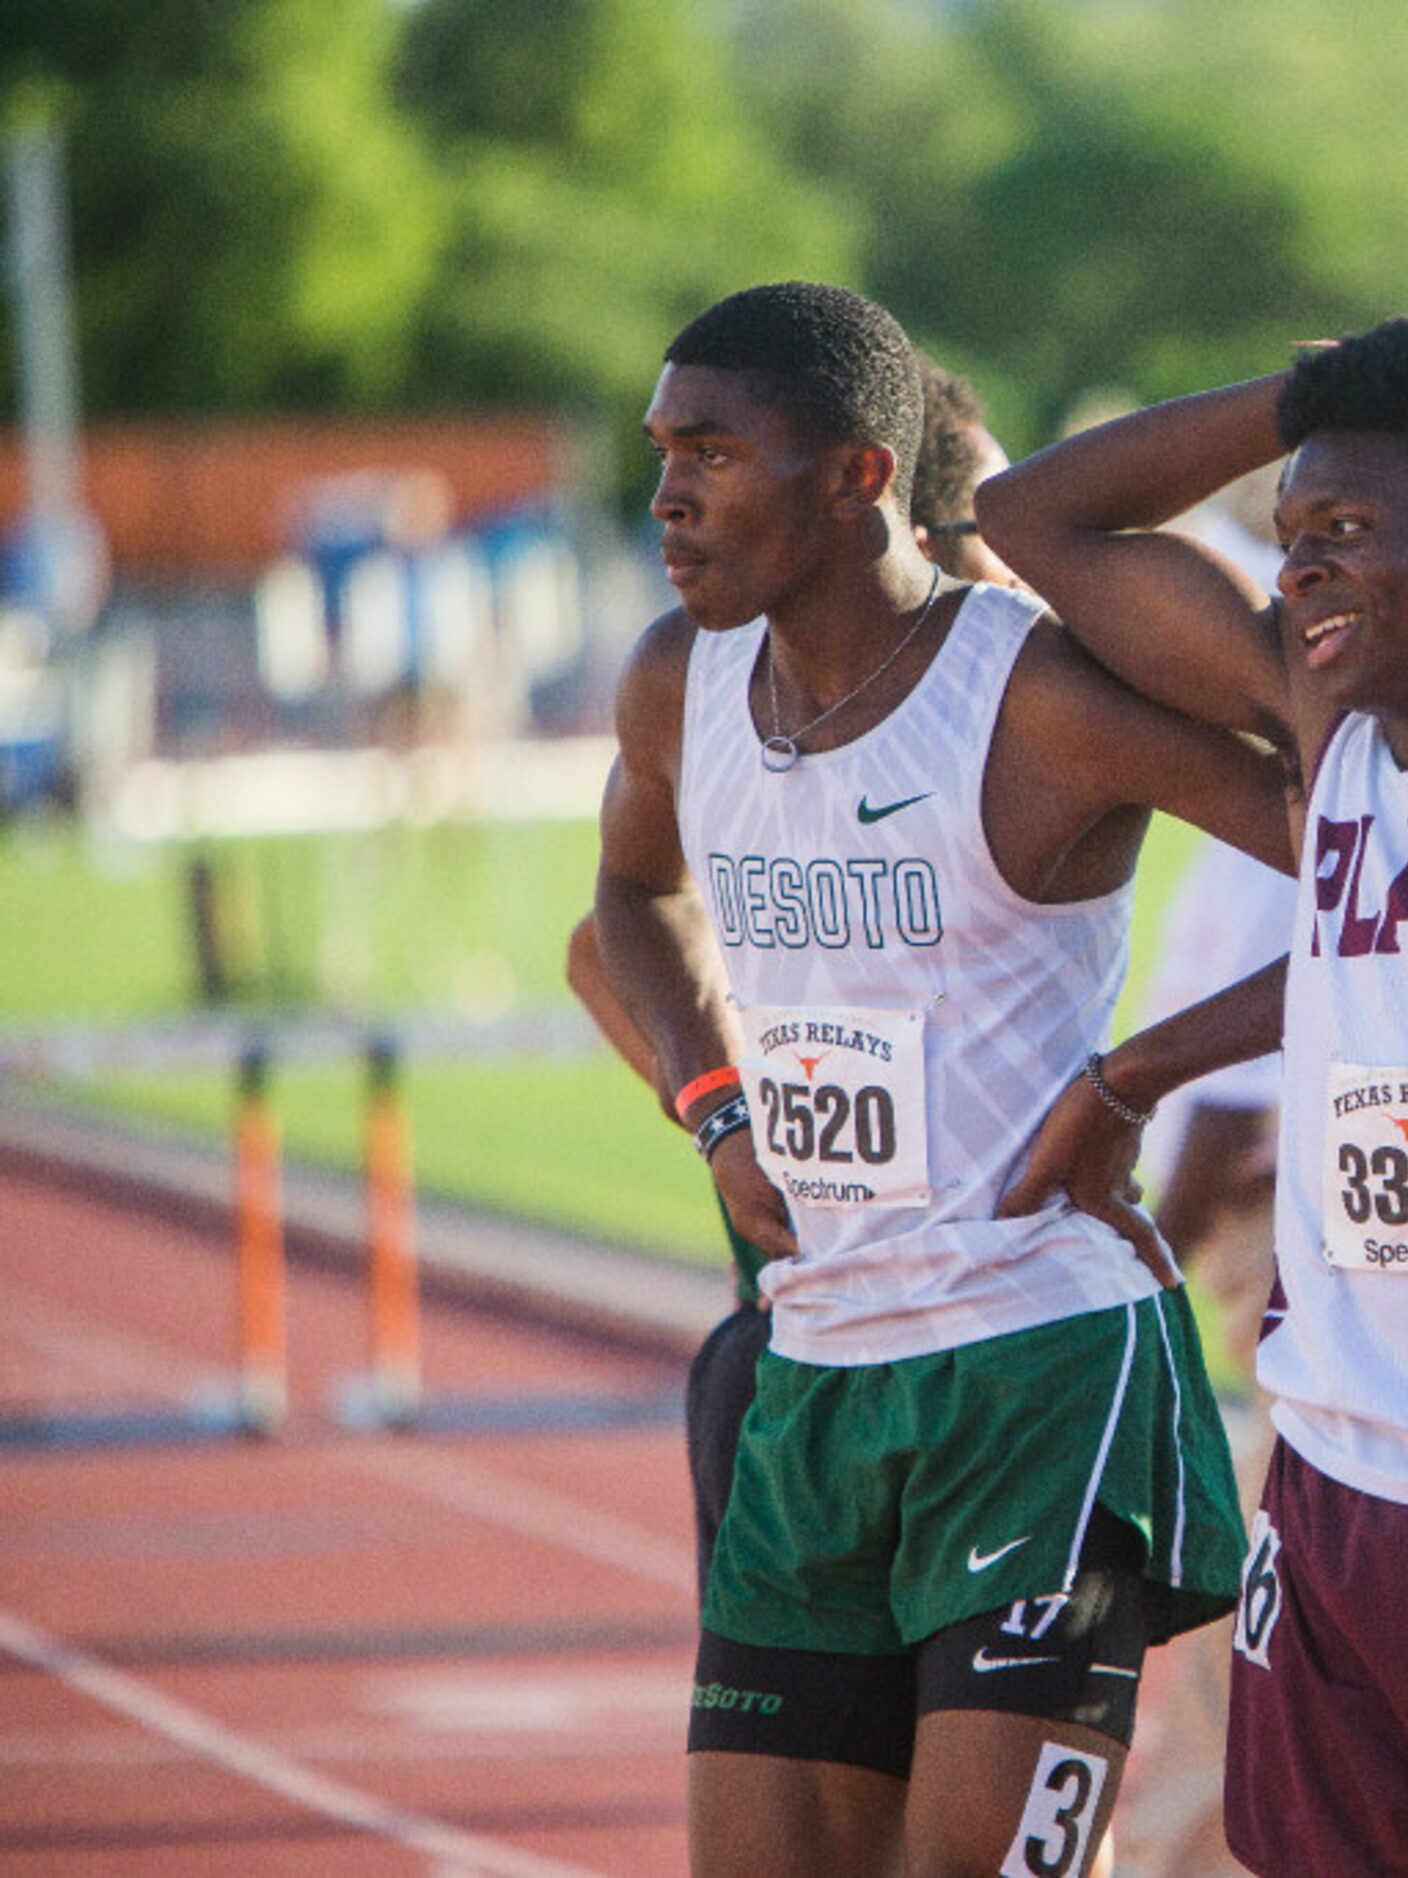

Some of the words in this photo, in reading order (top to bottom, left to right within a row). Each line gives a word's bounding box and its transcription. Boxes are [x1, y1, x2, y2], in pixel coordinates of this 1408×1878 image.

[708, 853, 944, 949] DESOTO
[805, 1021, 893, 1062] RELAYS
[759, 1077, 897, 1165] 2520
[1333, 1084, 1393, 1118] TEXAS
[1001, 1593, 1068, 1640] 17
[1245, 1532, 1277, 1650] 6
[1024, 1758, 1092, 1878] 3
